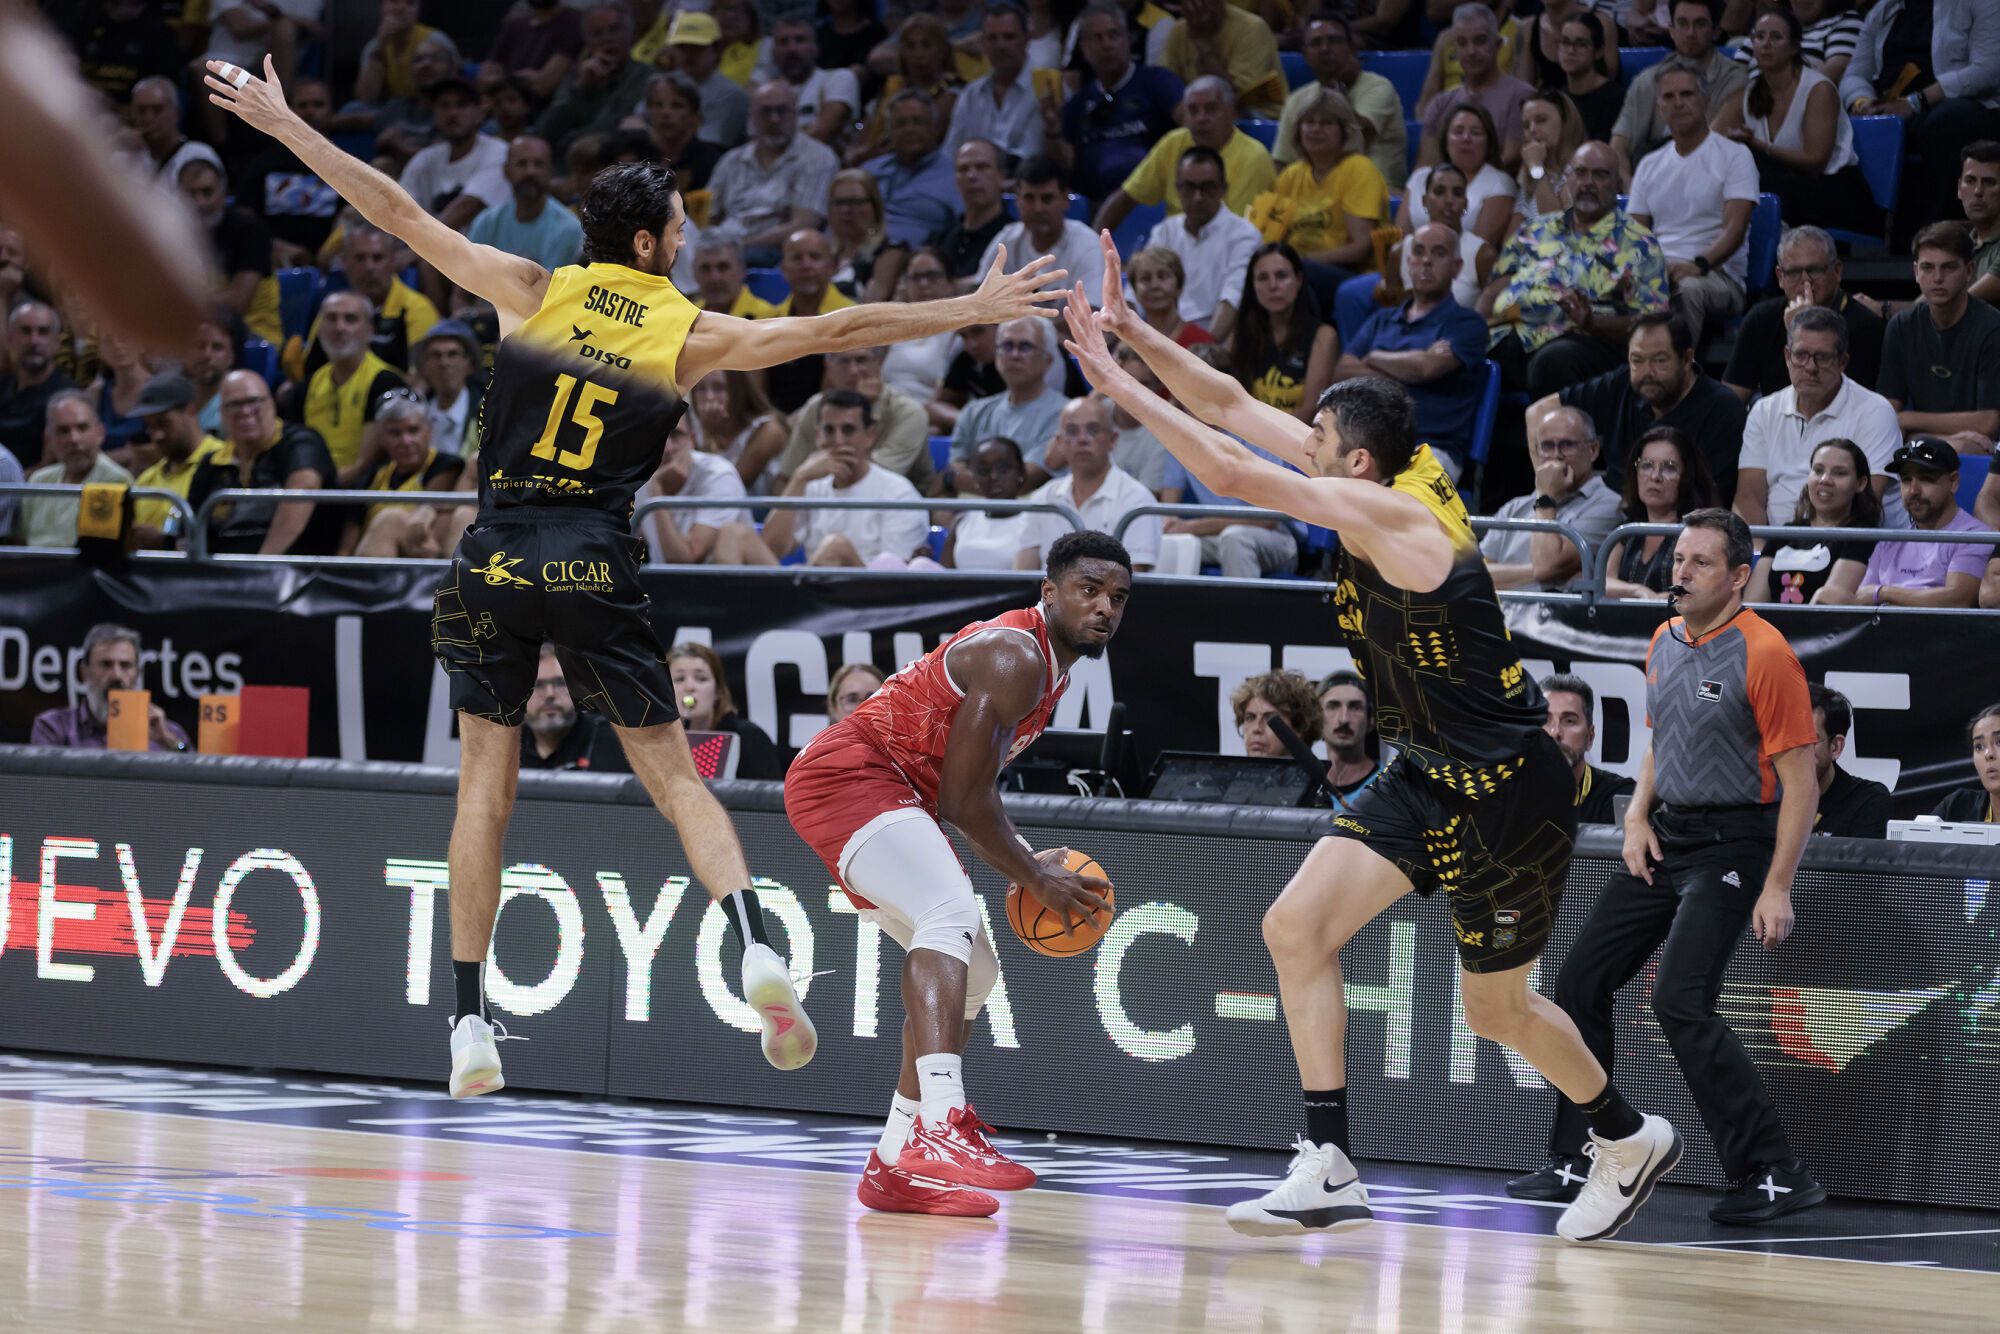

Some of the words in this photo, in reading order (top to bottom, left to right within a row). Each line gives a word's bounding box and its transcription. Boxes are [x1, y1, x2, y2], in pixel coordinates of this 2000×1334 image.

[584, 285, 649, 328] SASTRE
[530, 373, 620, 471] 15
[542, 560, 613, 584] CICAR
[545, 584, 574, 593] Canary
[576, 582, 601, 592] Islands
[601, 584, 614, 593] Car
[0, 626, 245, 708] Deprtes
[0, 834, 321, 998] EVO
